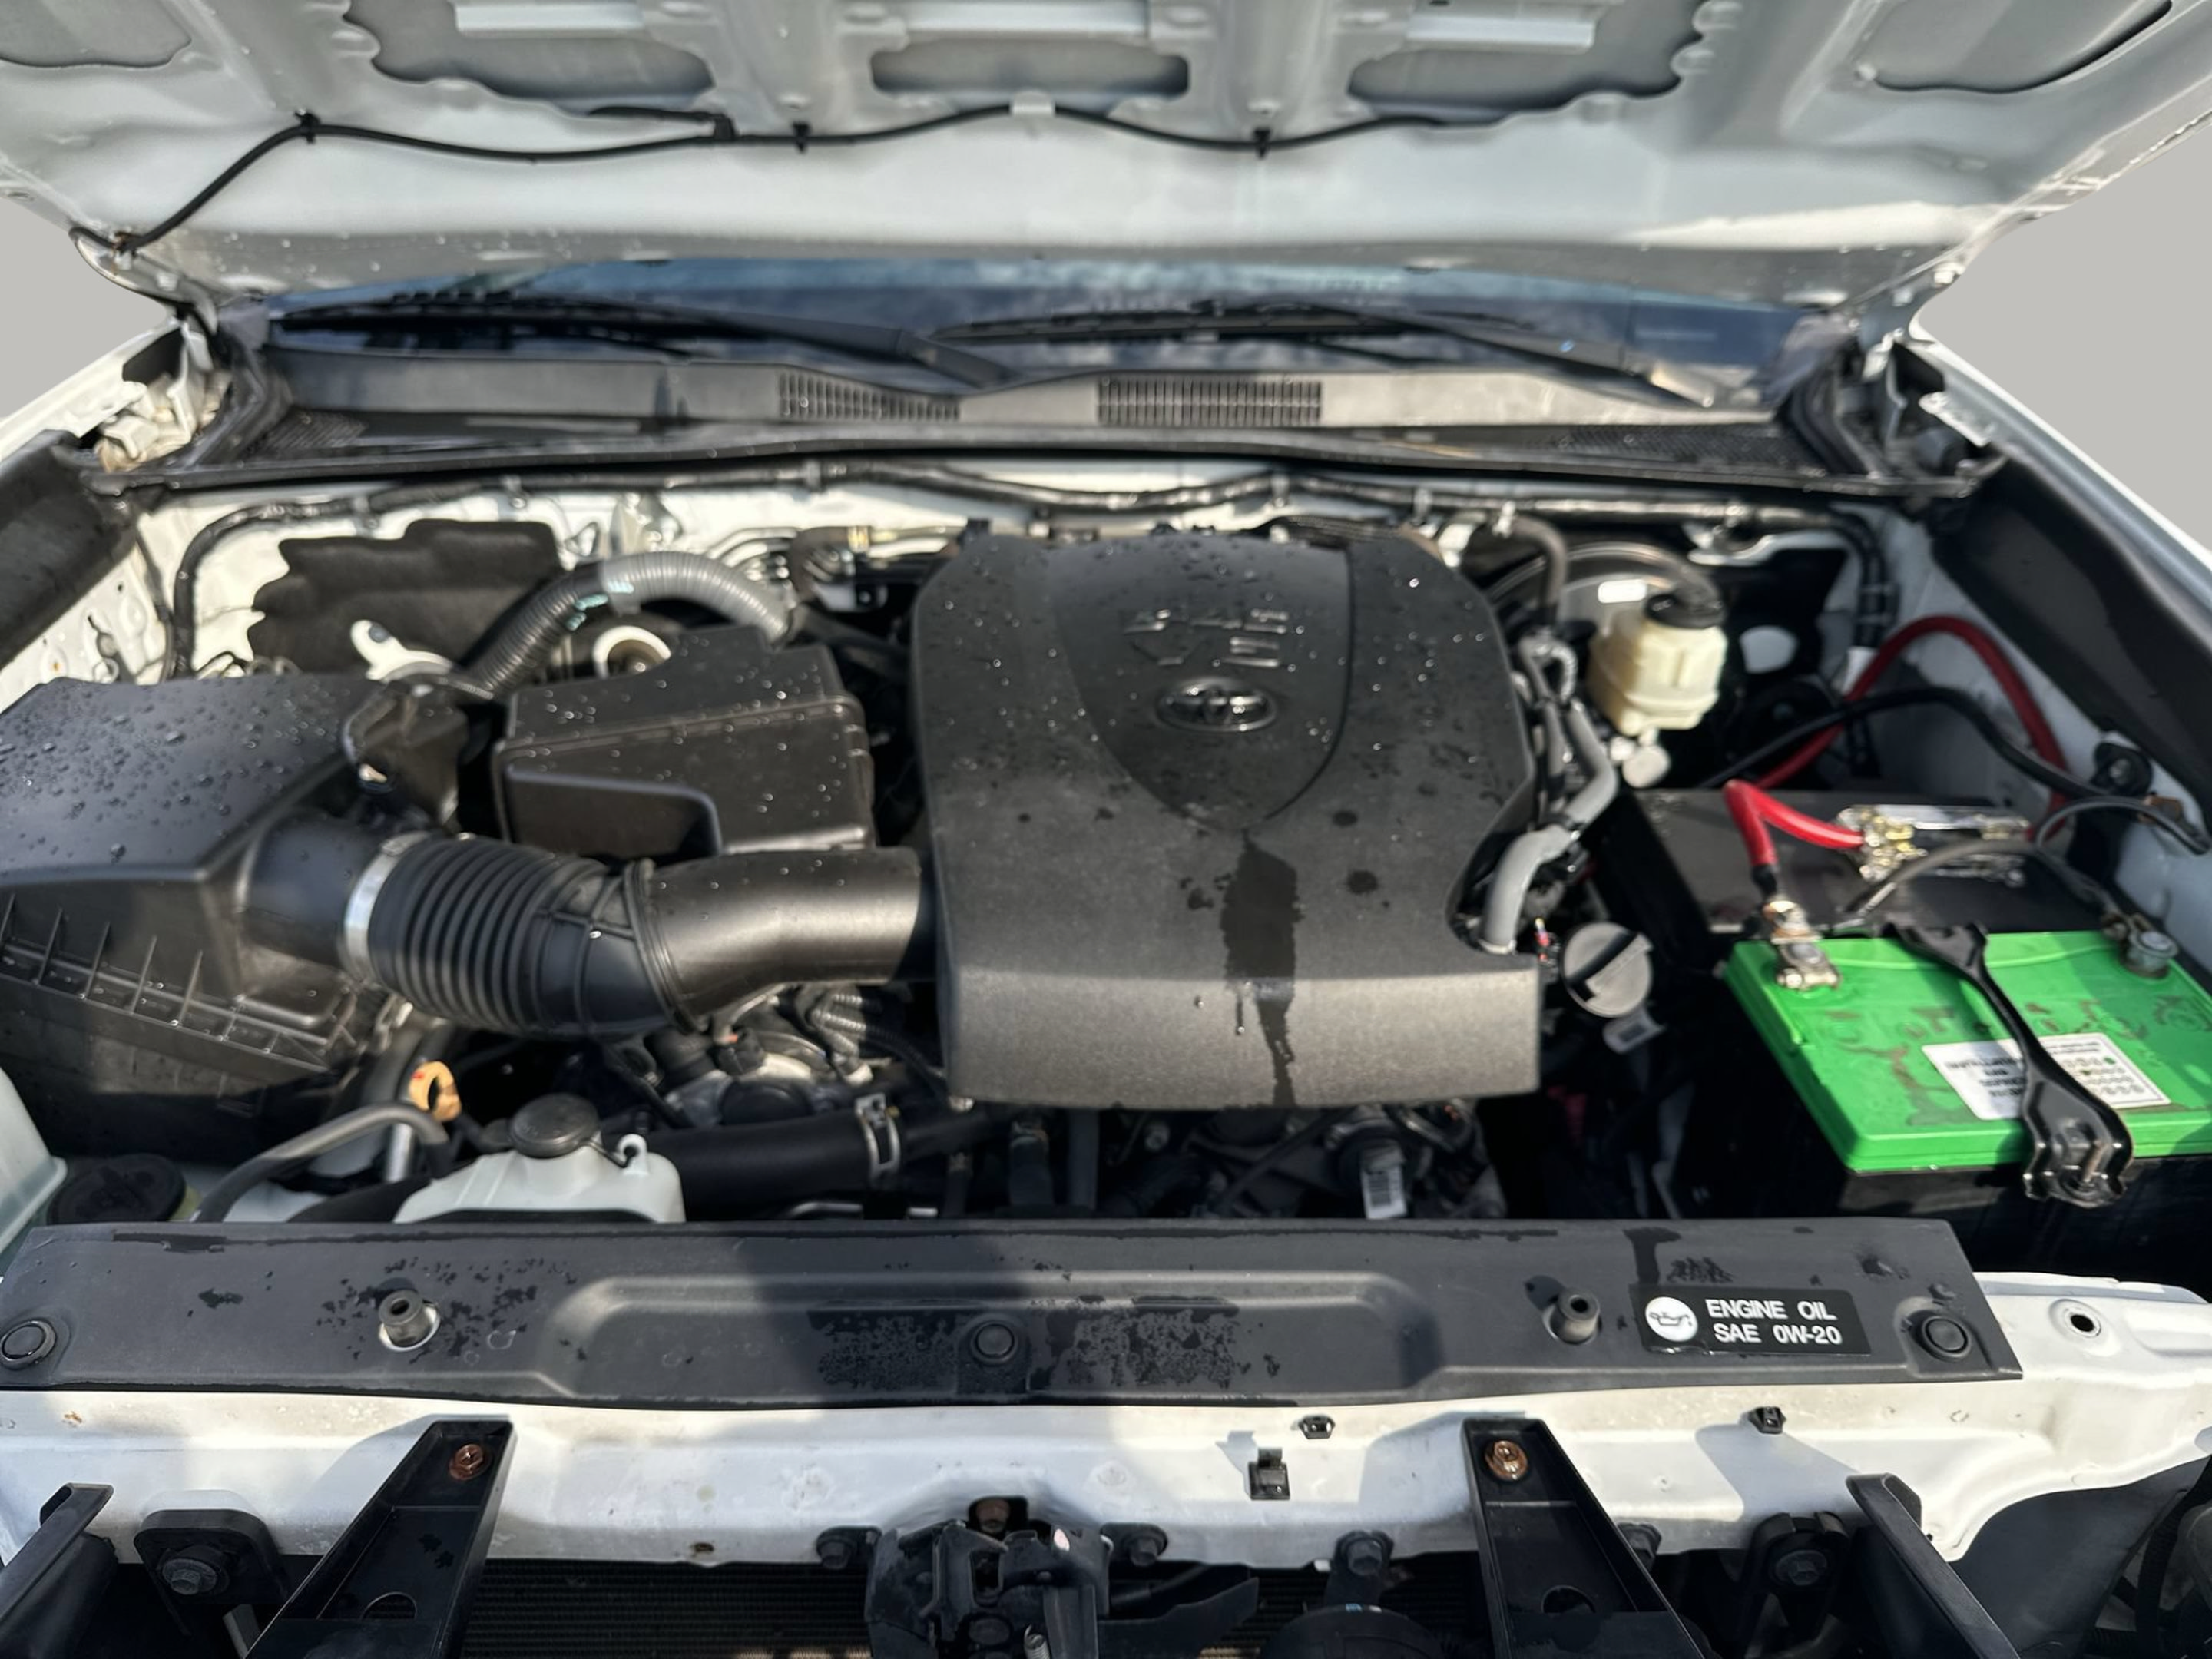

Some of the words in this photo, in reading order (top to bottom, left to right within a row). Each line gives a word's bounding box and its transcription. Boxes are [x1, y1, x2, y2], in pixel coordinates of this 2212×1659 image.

[1704, 1298, 1788, 1320] ENGINE
[1797, 1300, 1838, 1320] OIL
[1713, 1323, 1762, 1343] SAE
[1772, 1324, 1843, 1345] 0W-20
